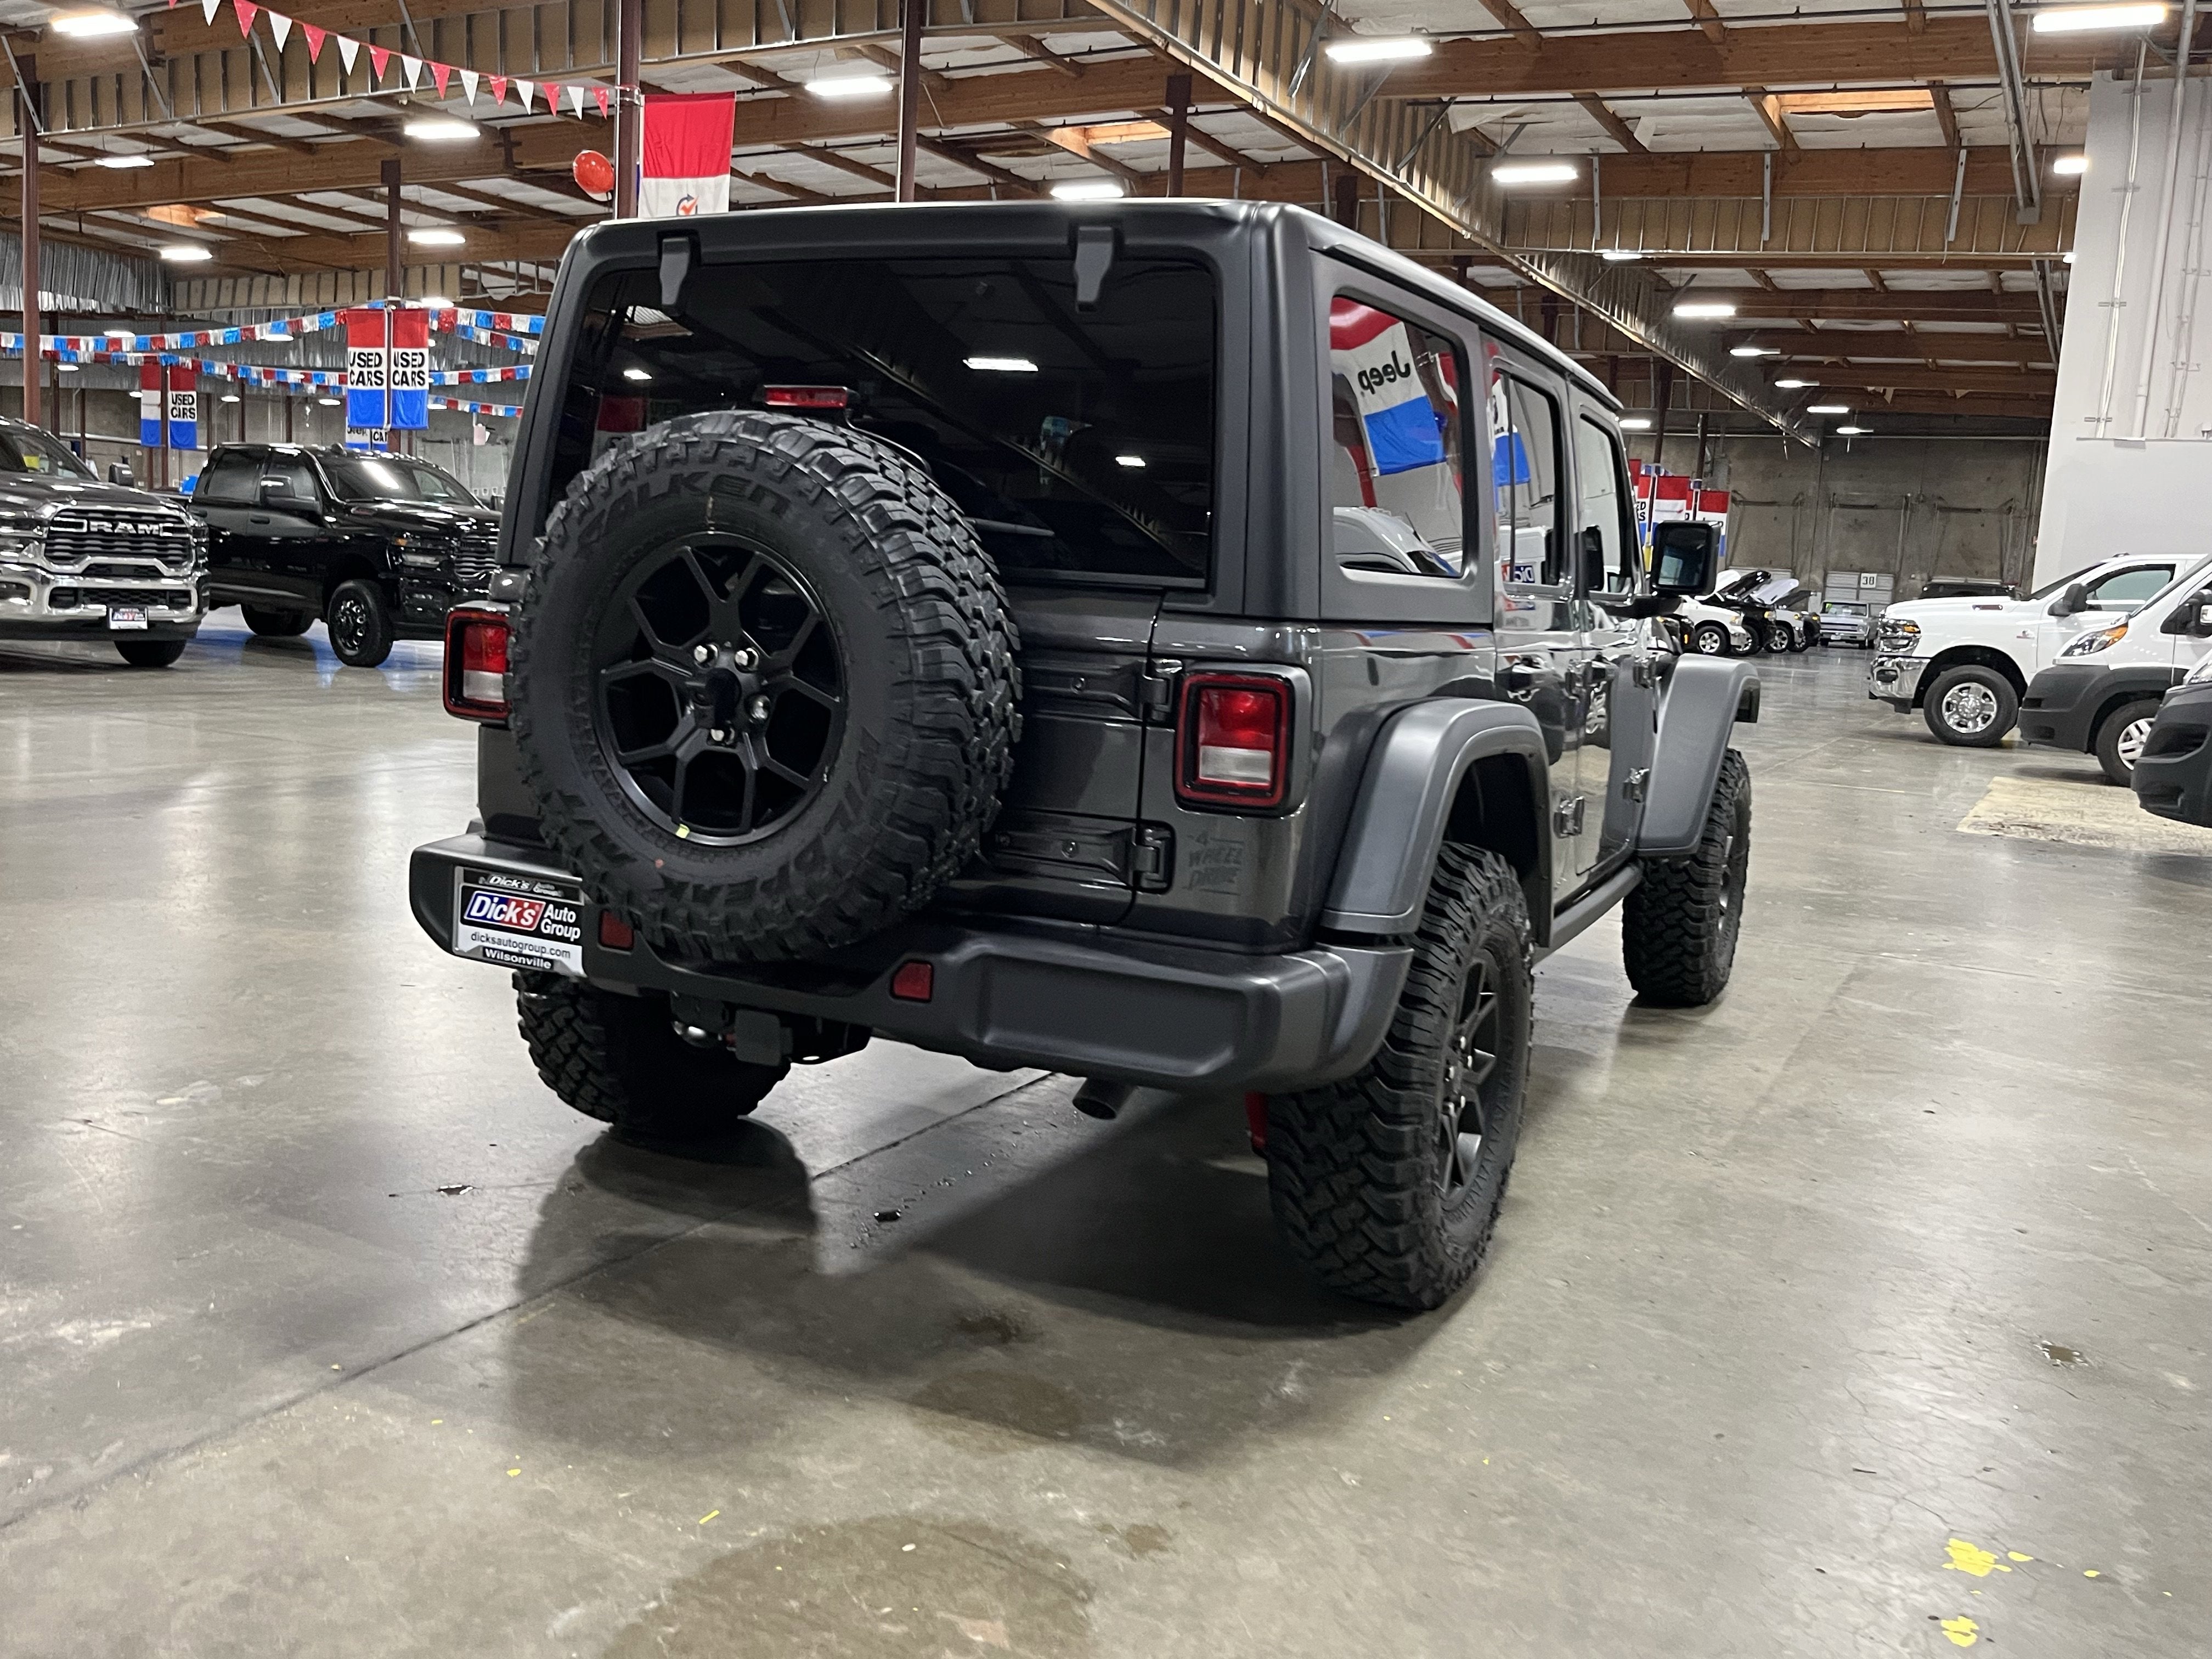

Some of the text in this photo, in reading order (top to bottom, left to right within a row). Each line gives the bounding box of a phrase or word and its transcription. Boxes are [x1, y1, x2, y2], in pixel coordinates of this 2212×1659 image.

[349, 351, 383, 368] USED
[393, 352, 426, 368] USED
[349, 370, 384, 386] CARS
[392, 370, 426, 386] CARS
[171, 392, 195, 405] USED
[89, 520, 161, 535] RAM
[1862, 576, 1875, 585] 38
[489, 876, 531, 889] Dick's
[470, 895, 576, 926] Dick's Auto
[540, 919, 581, 941] Group
[470, 932, 571, 959] dicksautogroup.com
[485, 948, 552, 969] Wilsonville
